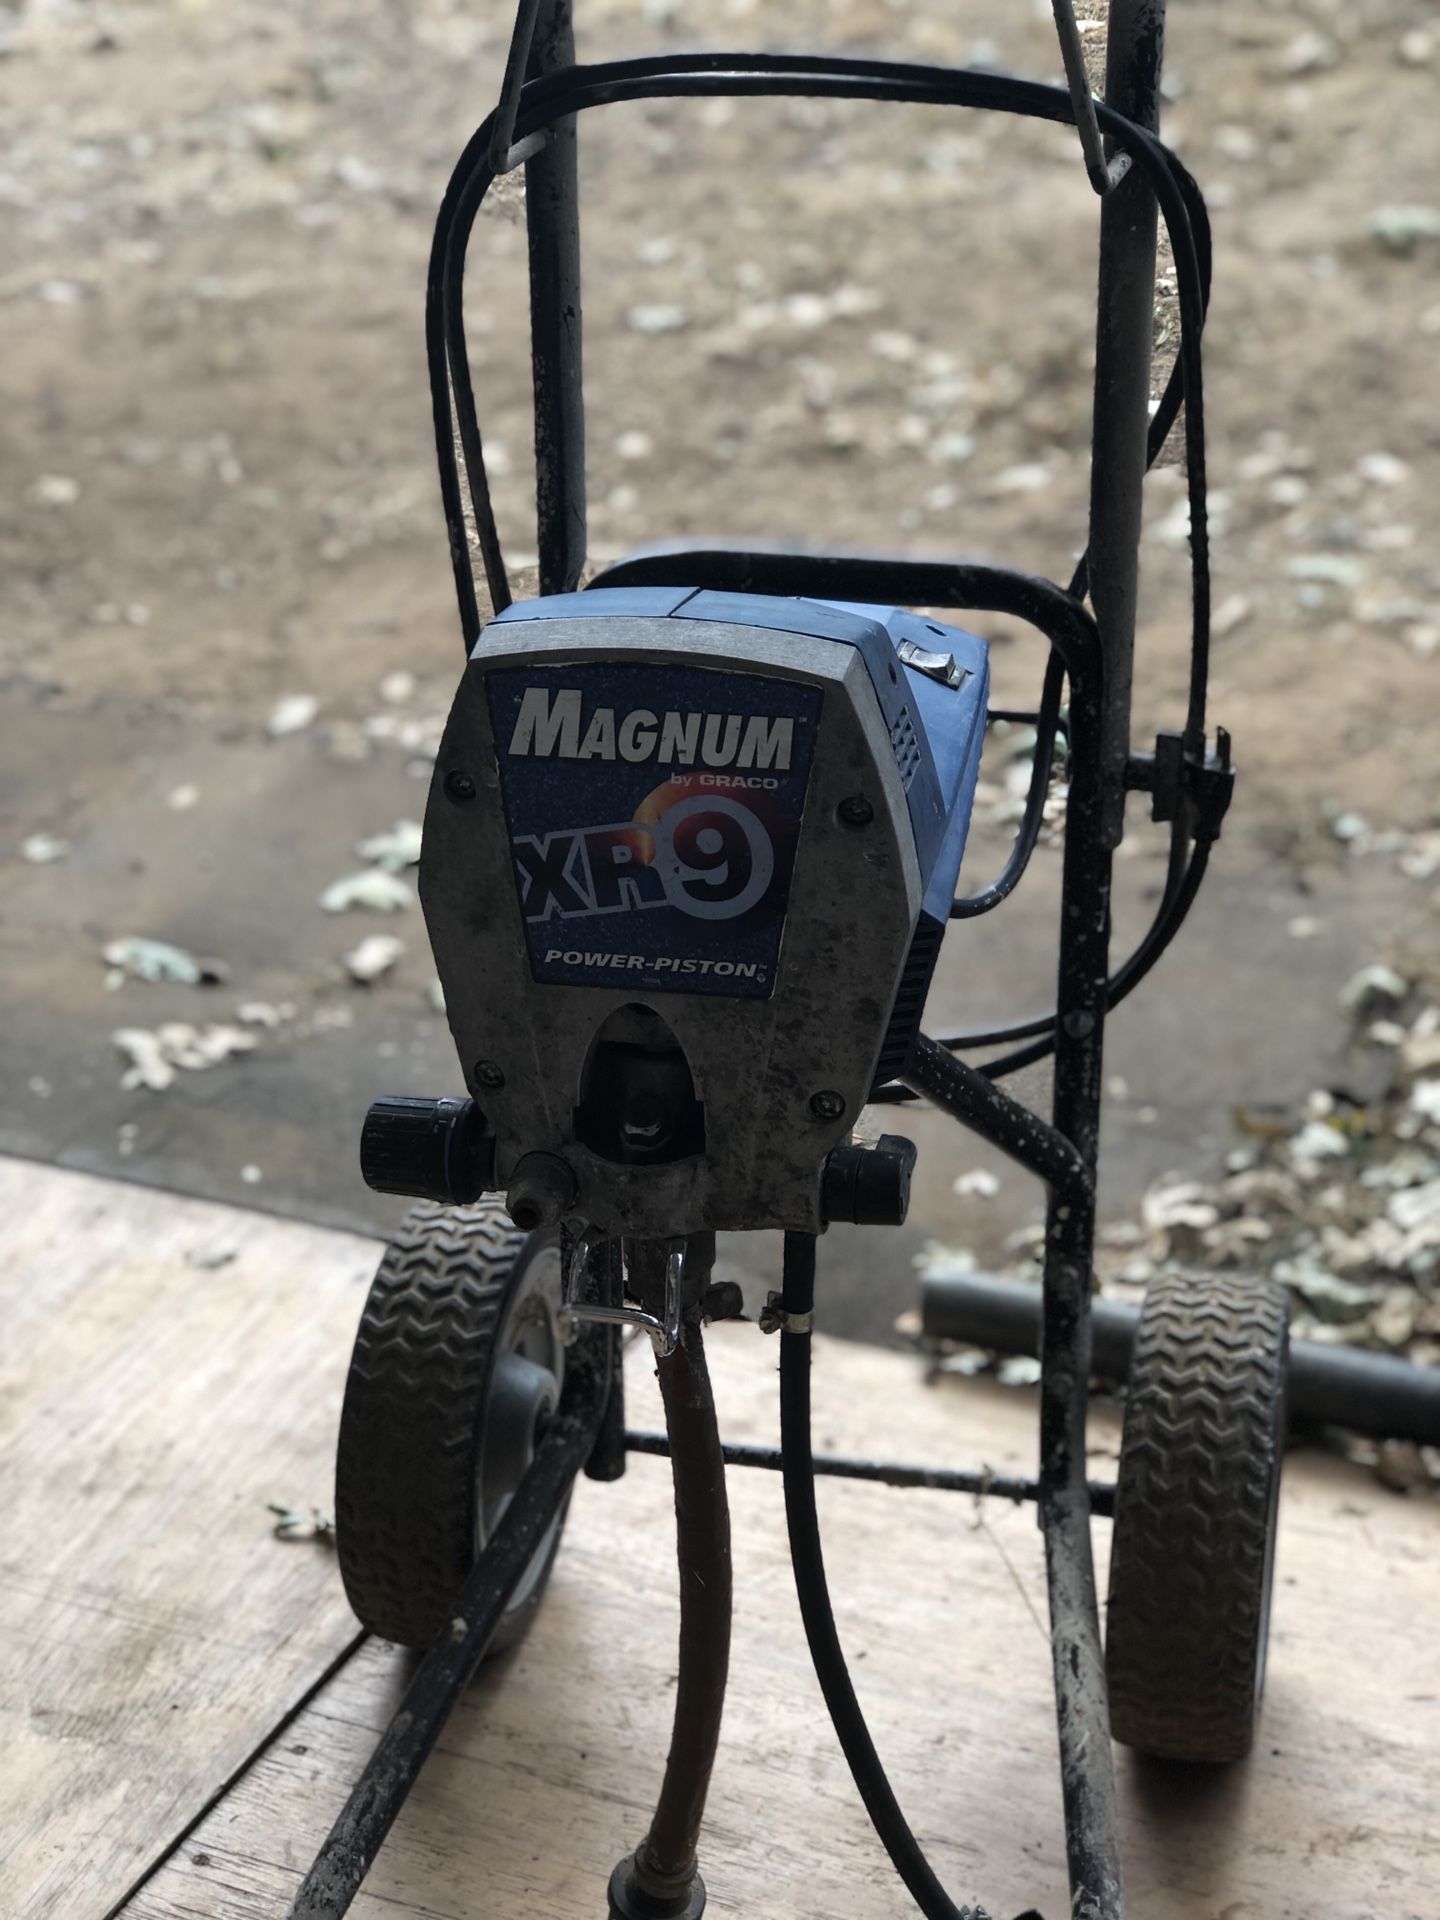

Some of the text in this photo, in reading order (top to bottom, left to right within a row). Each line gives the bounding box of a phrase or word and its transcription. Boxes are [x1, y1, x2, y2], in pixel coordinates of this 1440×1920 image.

[508, 687, 794, 770] MAGNUM
[671, 772, 779, 790] by GRACO
[544, 950, 758, 978] POWER-PISTON
